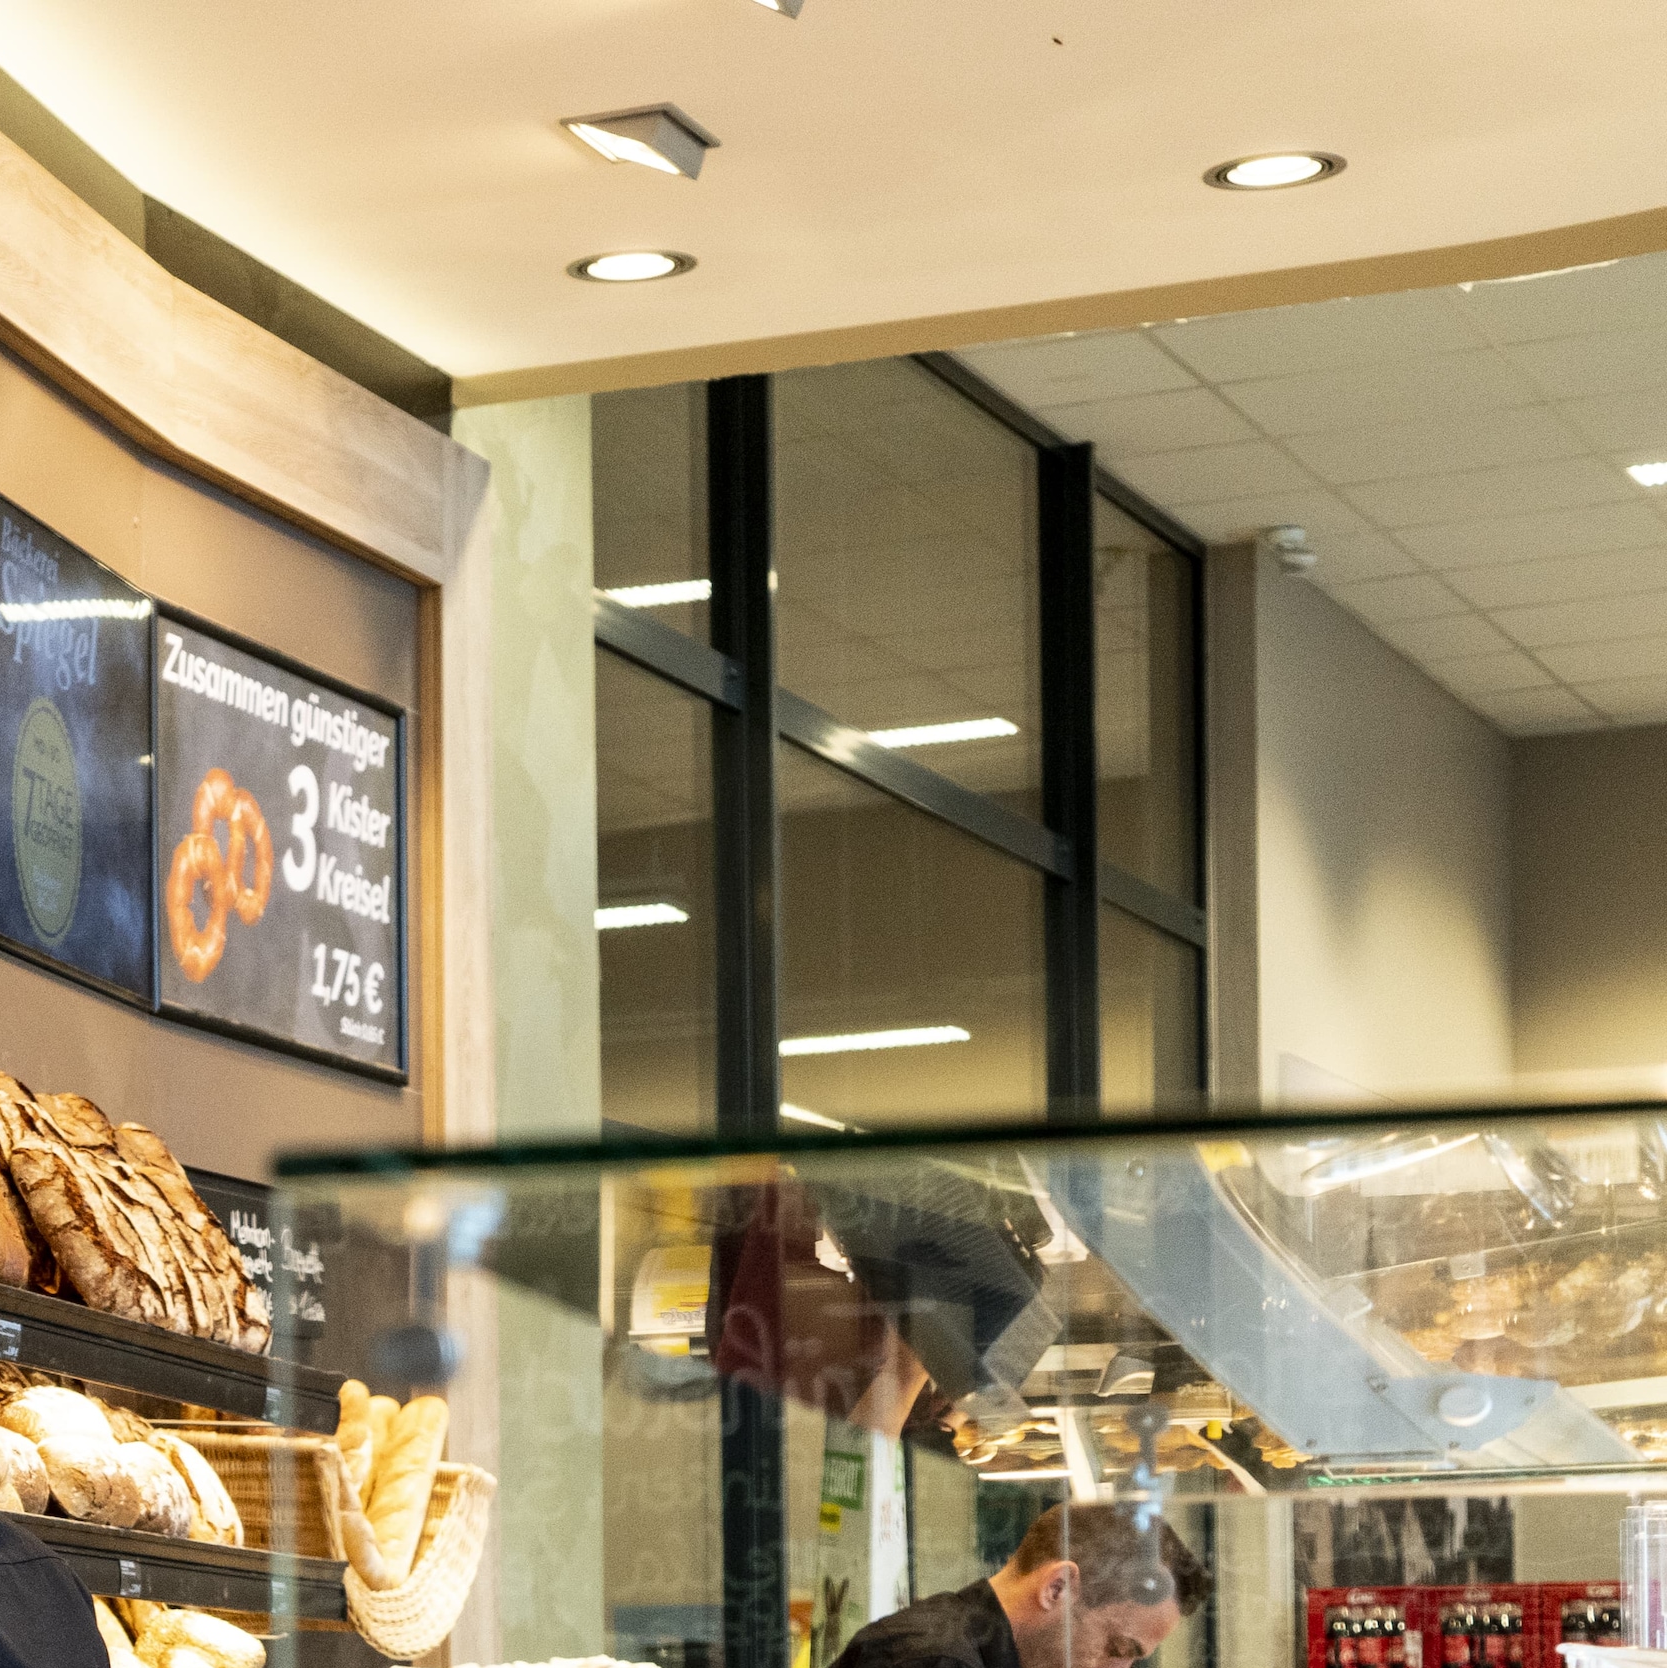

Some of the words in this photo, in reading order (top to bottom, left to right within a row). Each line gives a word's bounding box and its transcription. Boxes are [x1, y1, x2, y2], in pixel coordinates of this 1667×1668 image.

[162, 633, 289, 728] Zusammen
[290, 686, 389, 771] günstiger
[282, 764, 320, 891] 3
[327, 781, 389, 849] Kister
[317, 852, 390, 924] Kreisel
[312, 942, 361, 1007] 1,75
[364, 961, 385, 1014] €
